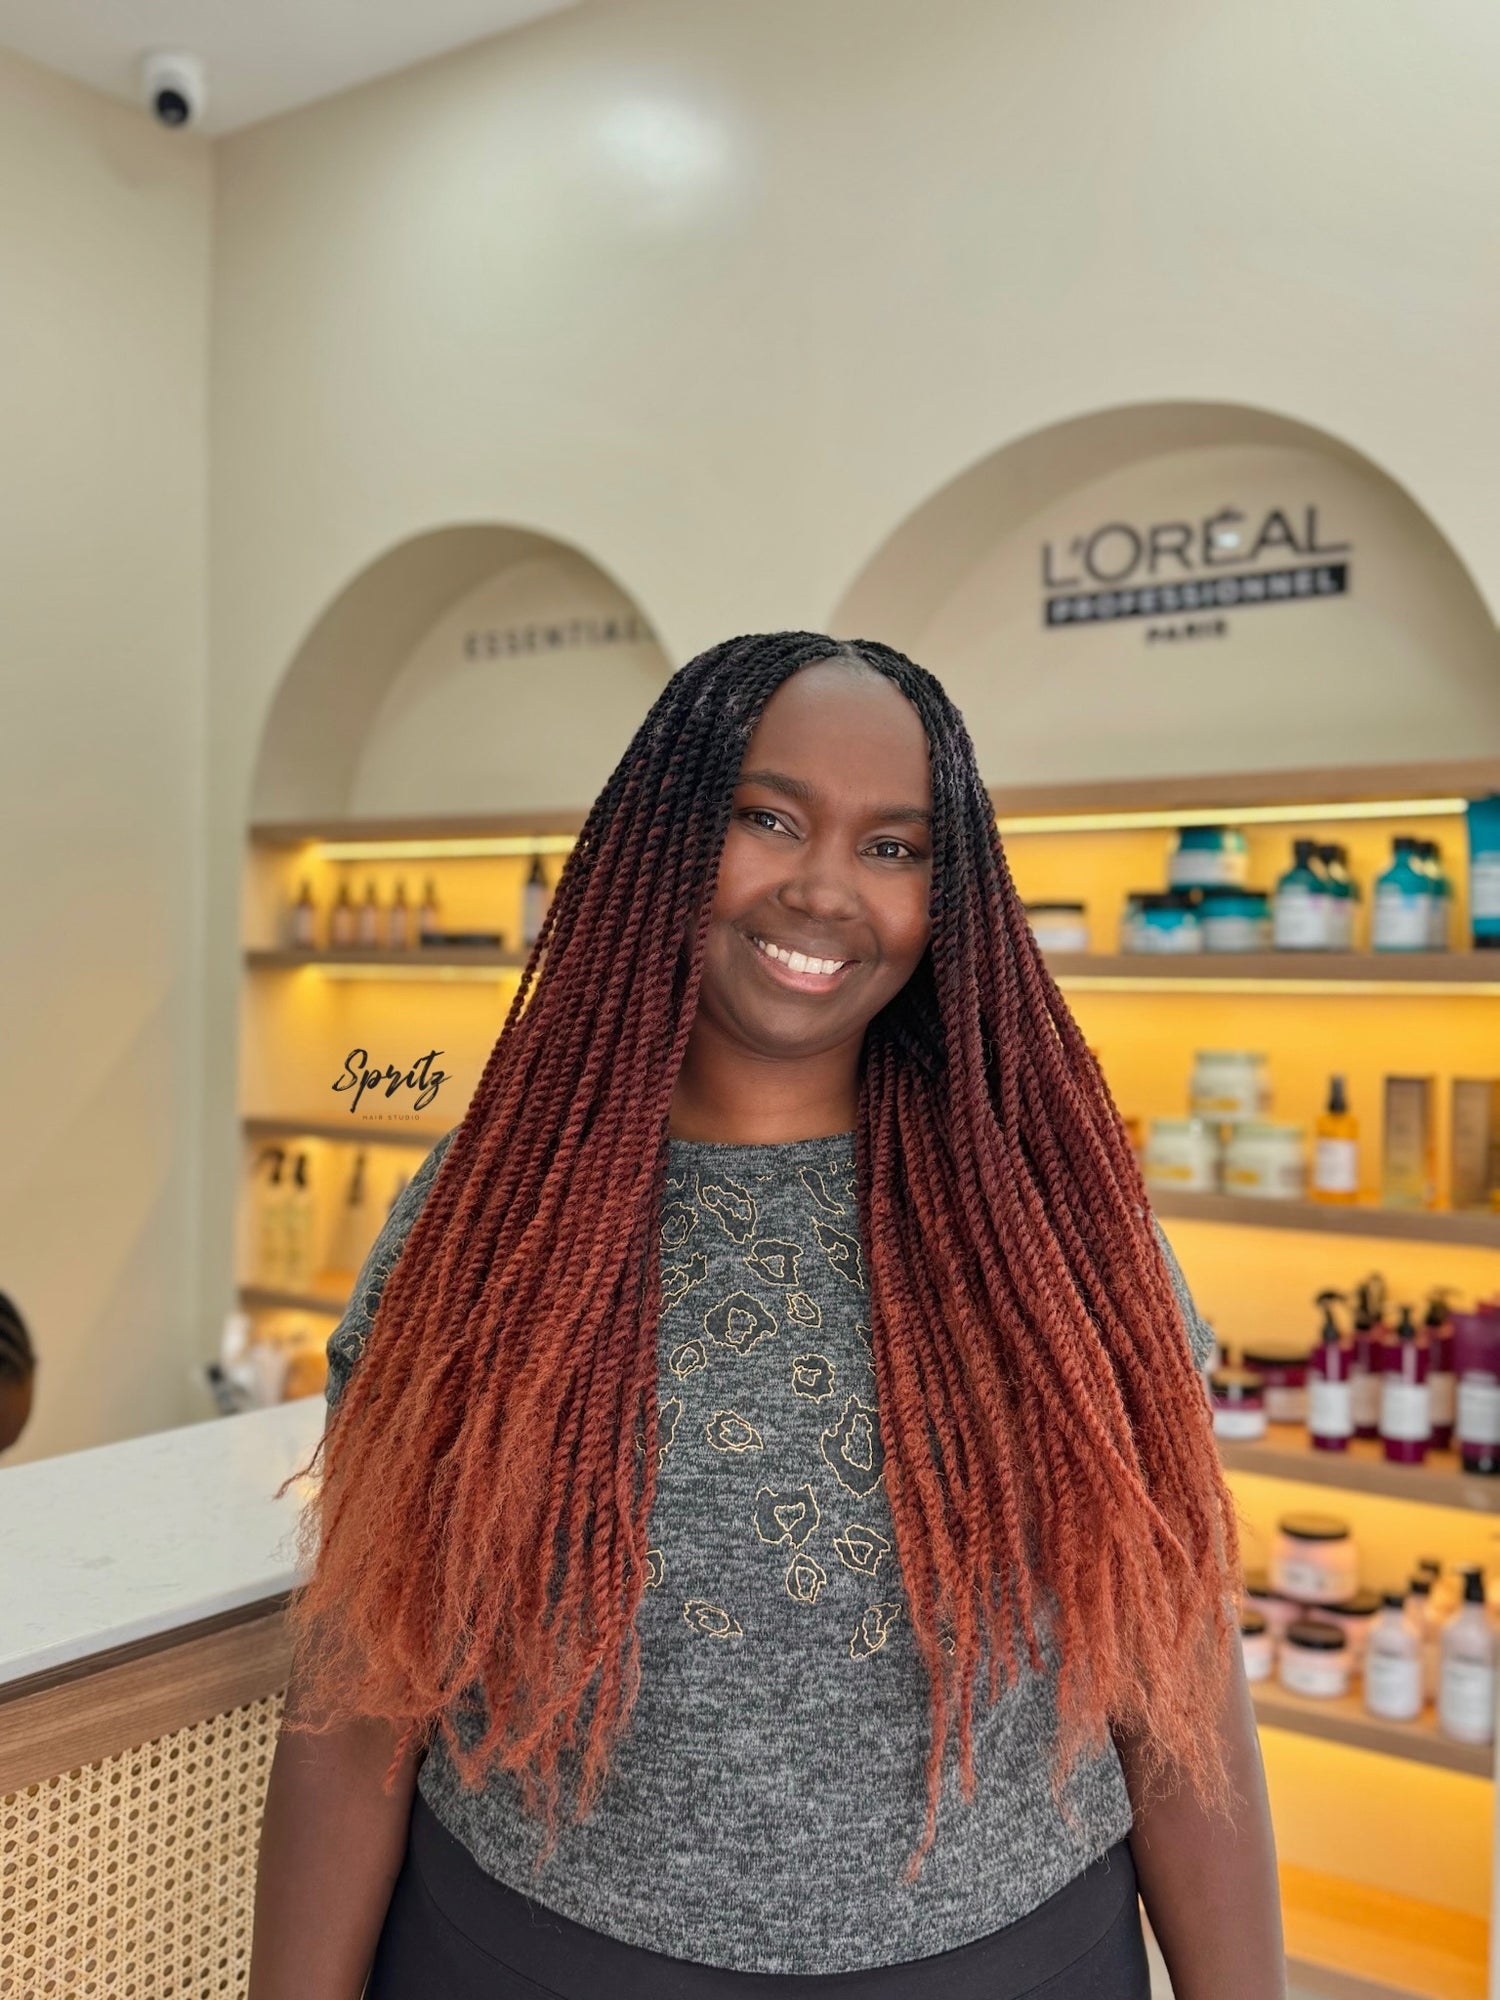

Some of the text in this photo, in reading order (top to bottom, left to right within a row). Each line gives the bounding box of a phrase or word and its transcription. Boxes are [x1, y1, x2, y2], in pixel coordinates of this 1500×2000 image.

[1042, 504, 1353, 588] L'ORÉAL
[1051, 567, 1337, 623] PROFESSIONNEL
[1146, 618, 1227, 647] PARIS
